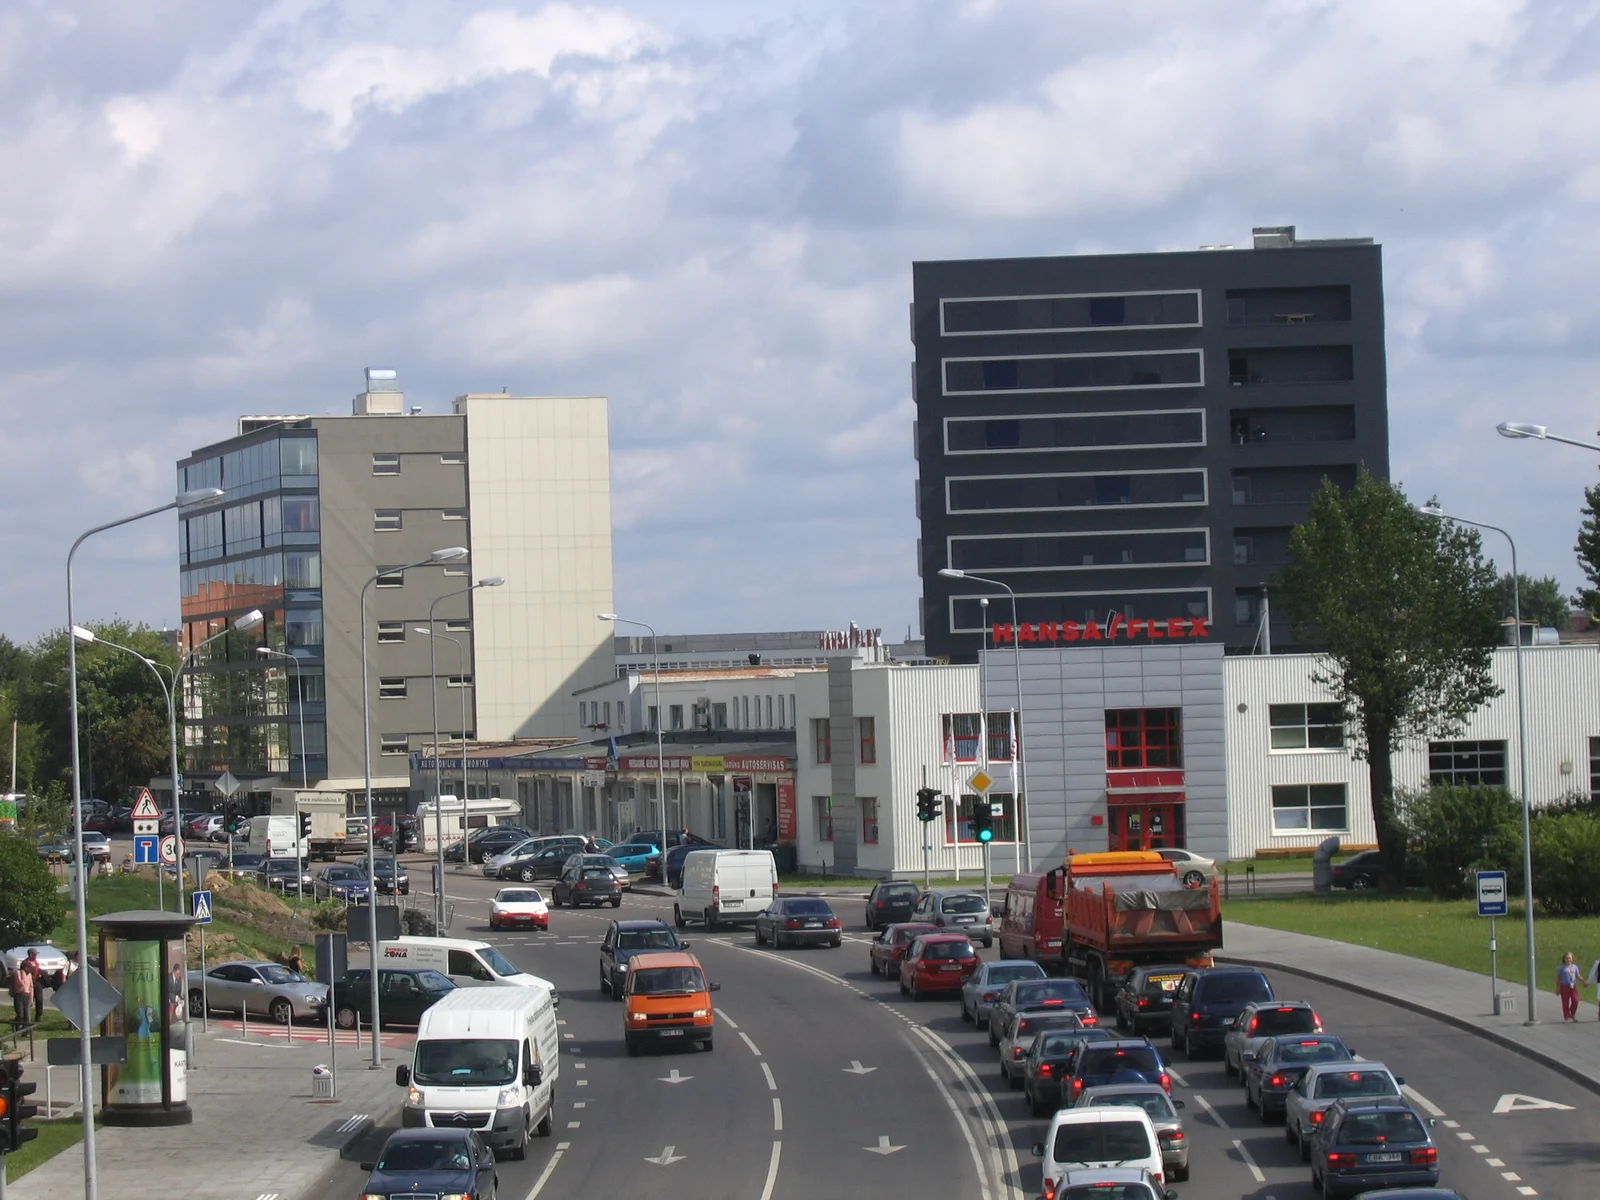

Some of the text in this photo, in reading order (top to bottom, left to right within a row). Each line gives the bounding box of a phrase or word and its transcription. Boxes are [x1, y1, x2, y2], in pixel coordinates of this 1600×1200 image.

[992, 617, 1208, 642] HANSA FLEX
[819, 631, 850, 650] HANSA
[461, 759, 489, 768] RMONTAS
[741, 760, 784, 770] AUTOSERVISAS
[130, 972, 153, 982] TAU
